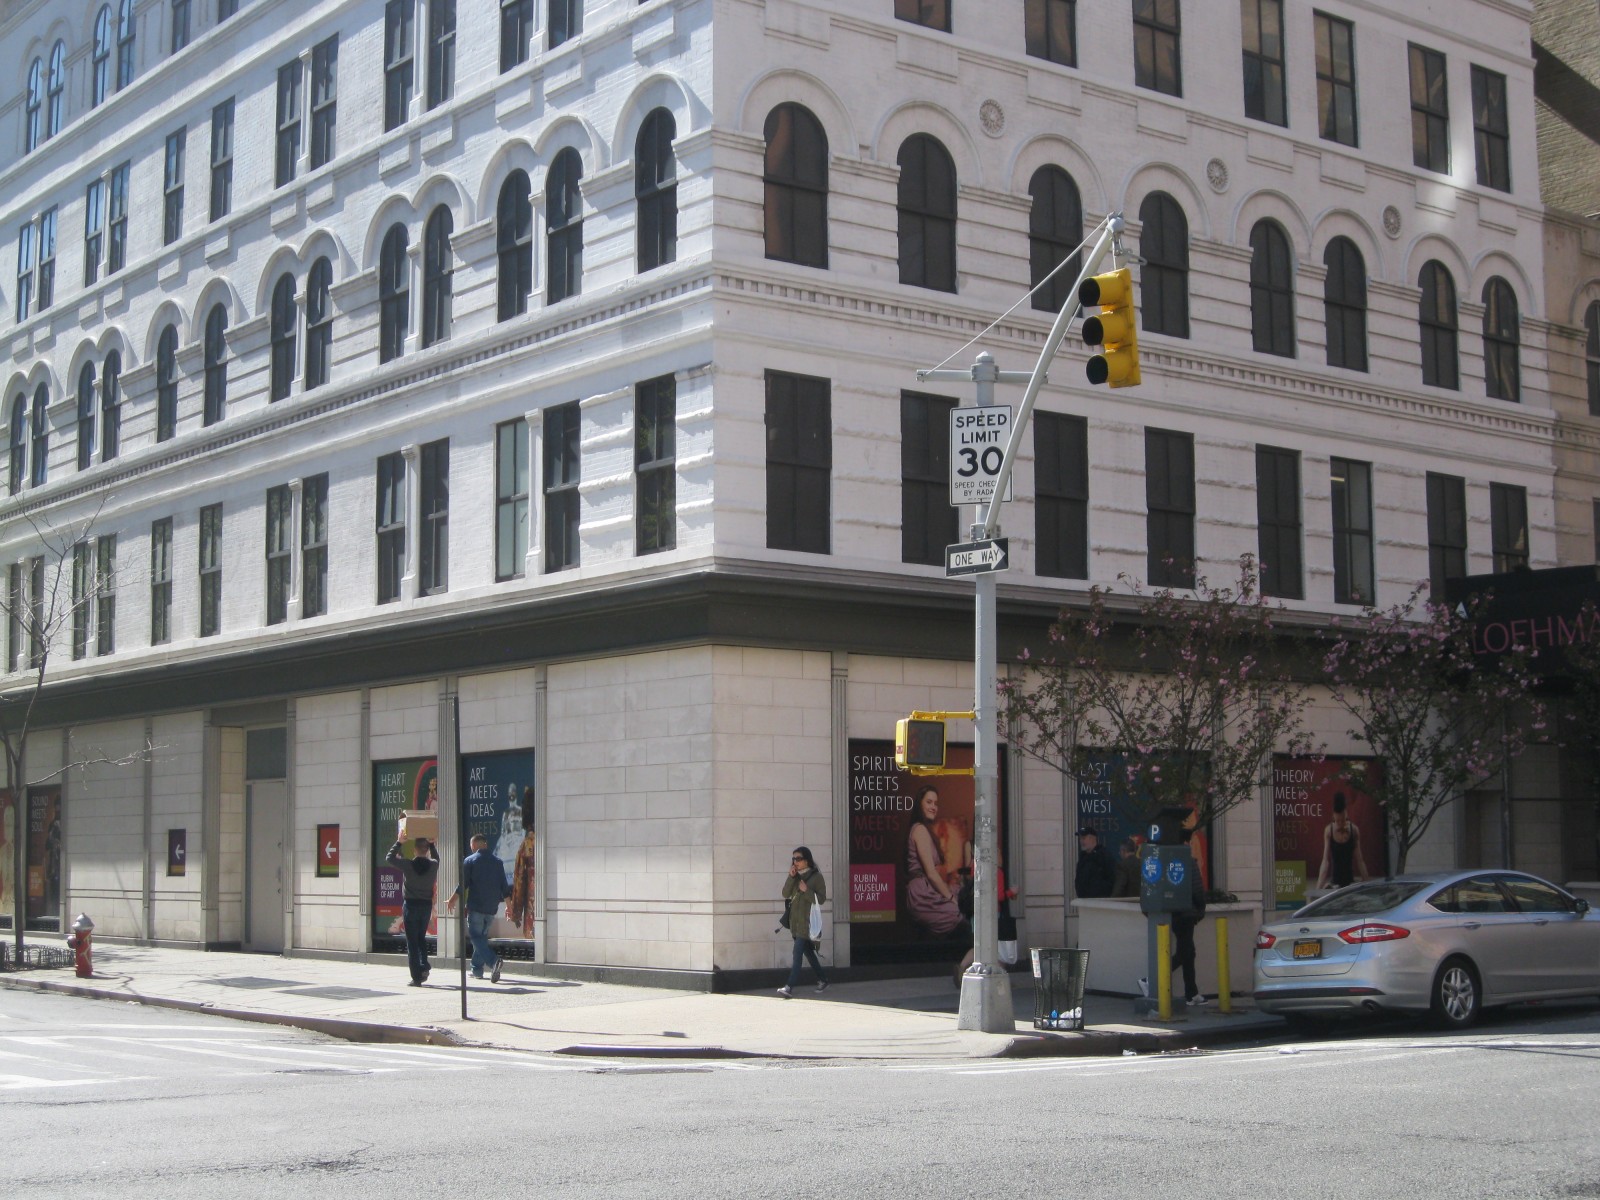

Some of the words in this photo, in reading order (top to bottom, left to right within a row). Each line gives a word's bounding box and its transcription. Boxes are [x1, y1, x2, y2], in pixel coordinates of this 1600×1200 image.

[955, 413, 1007, 429] SPEED
[961, 430, 1001, 444] LIMIT
[957, 446, 1004, 477] 30
[954, 481, 975, 489] SPEED
[978, 480, 996, 488] CHEC
[963, 489, 972, 497] BY
[976, 488, 994, 496] RADA
[955, 553, 973, 566] ONE
[981, 548, 1000, 563] WAY
[380, 772, 406, 787] HEART
[469, 767, 487, 782] ART
[1274, 768, 1315, 783] THEORY
[853, 775, 899, 791] MEETS
[380, 790, 406, 804] MEETS
[469, 784, 498, 799] MEETS
[1275, 786, 1308, 800] MEETS
[469, 802, 495, 817] IDEAS
[854, 795, 914, 811] SPIRITED
[1080, 799, 1111, 813] WEST
[1275, 803, 1322, 817] PRACTICE
[854, 815, 900, 831] MEETS
[1151, 824, 1160, 840] P
[854, 835, 884, 850] YOU
[380, 874, 394, 883] RUBIN
[853, 874, 878, 883] RUBIN
[1276, 876, 1301, 885] MUSEUM
[380, 882, 400, 891] MUSEUM
[853, 883, 888, 892] MUSEUM
[380, 890, 387, 899] OF
[387, 890, 395, 898] ART
[854, 892, 865, 901] OF
[866, 892, 881, 901] ART
